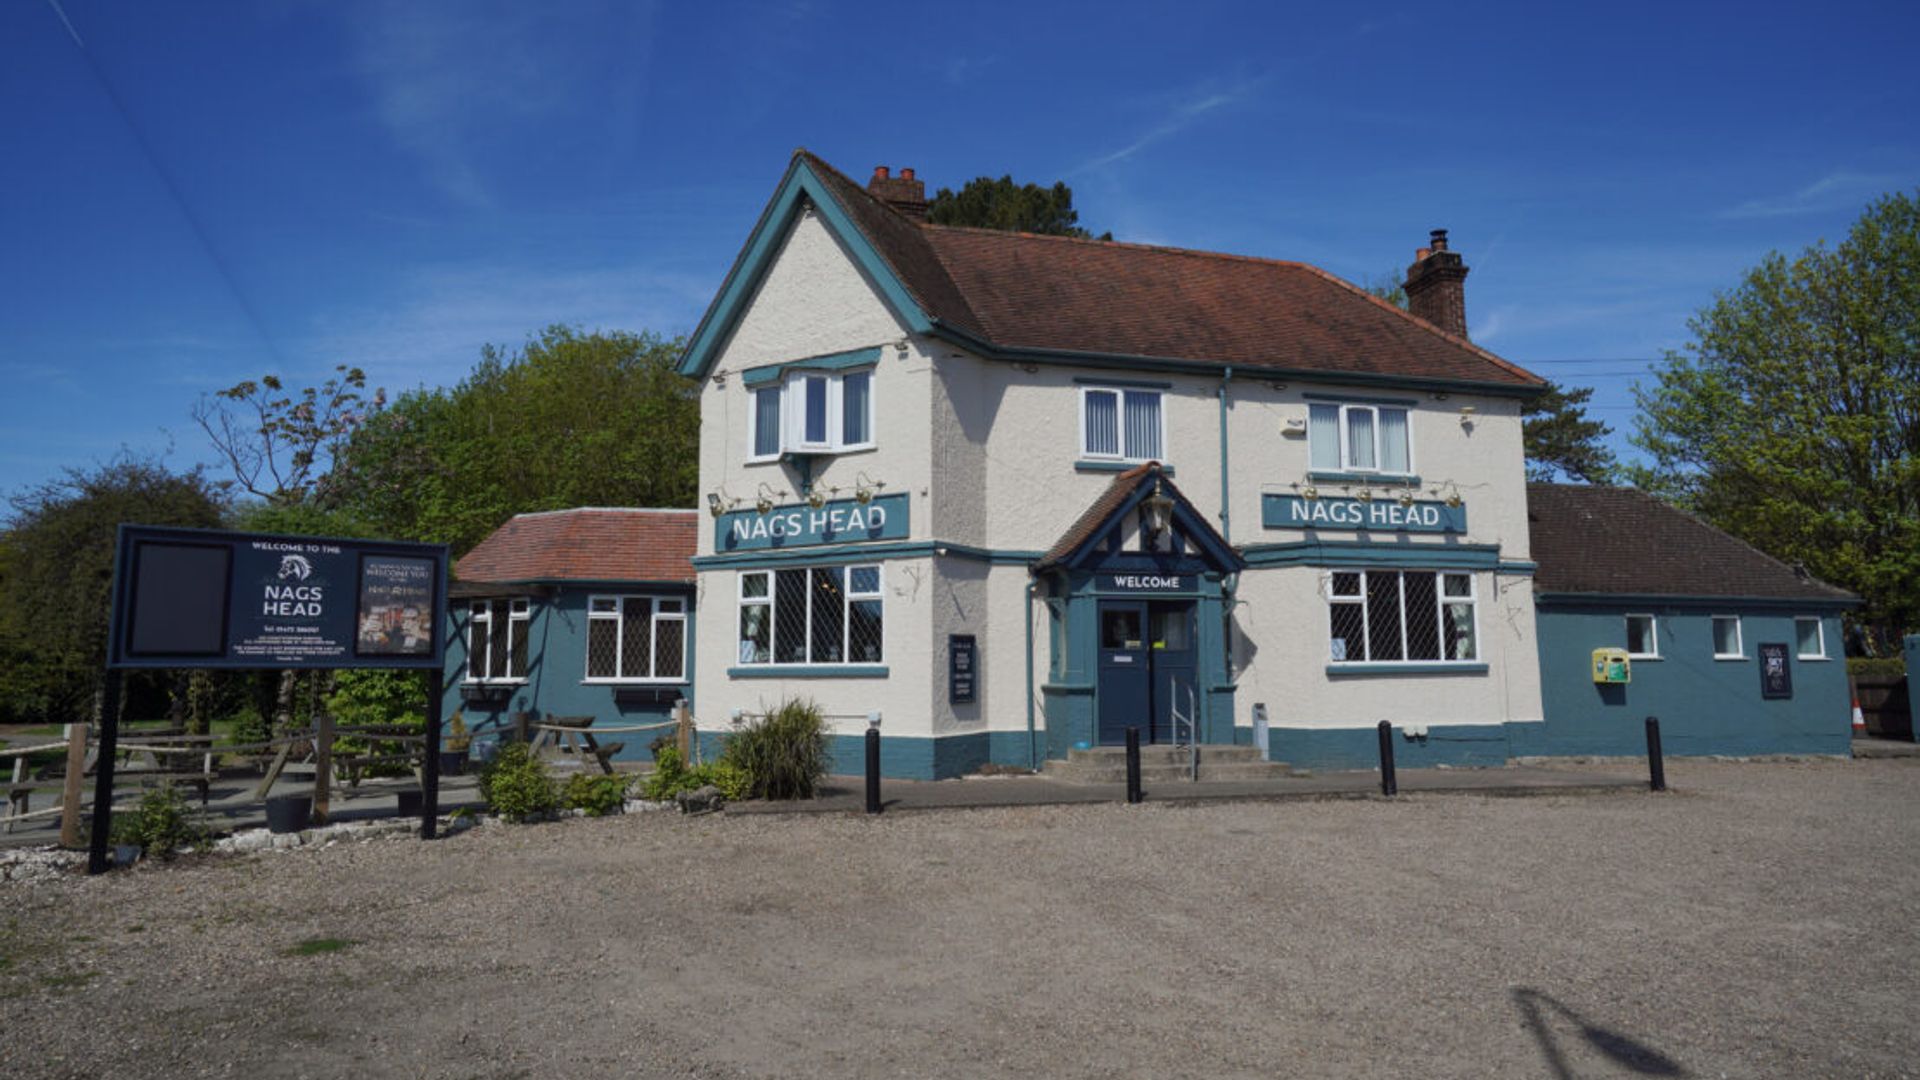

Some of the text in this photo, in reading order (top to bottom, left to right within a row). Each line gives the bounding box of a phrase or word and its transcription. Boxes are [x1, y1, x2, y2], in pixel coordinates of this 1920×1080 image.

[1291, 500, 1439, 526] NAGS HEAD
[733, 506, 886, 540] NAGS HEAD
[252, 542, 341, 554] WELCOME TO THE
[1113, 576, 1181, 588] WELCOME
[264, 585, 323, 601] NAGS
[263, 601, 322, 616] HEAD
